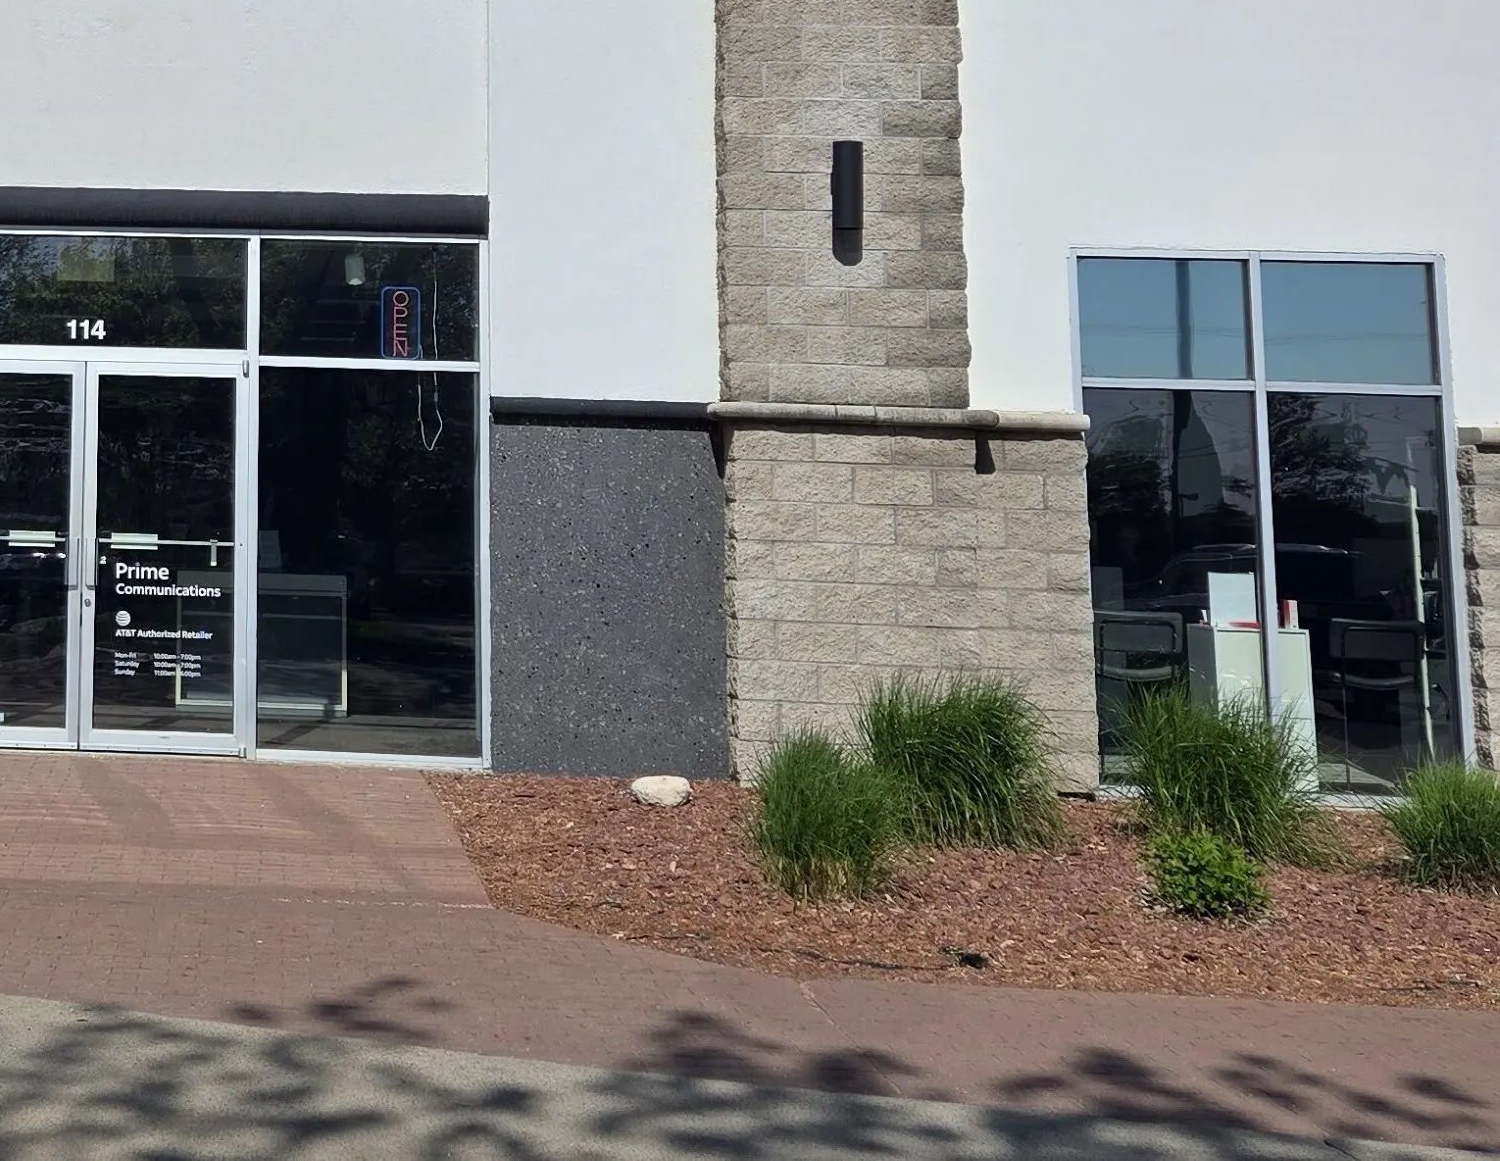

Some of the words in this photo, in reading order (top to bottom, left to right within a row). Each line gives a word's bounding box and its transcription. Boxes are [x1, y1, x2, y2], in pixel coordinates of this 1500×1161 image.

[66, 319, 107, 340] 114
[392, 290, 409, 357] OPEN
[115, 562, 169, 580] Prime
[115, 583, 221, 597] Communications
[115, 629, 136, 637] AT&T
[137, 629, 181, 638] Authorized
[182, 630, 213, 639] Retailer
[114, 660, 140, 668] Saturday
[114, 668, 136, 676] Sunday
